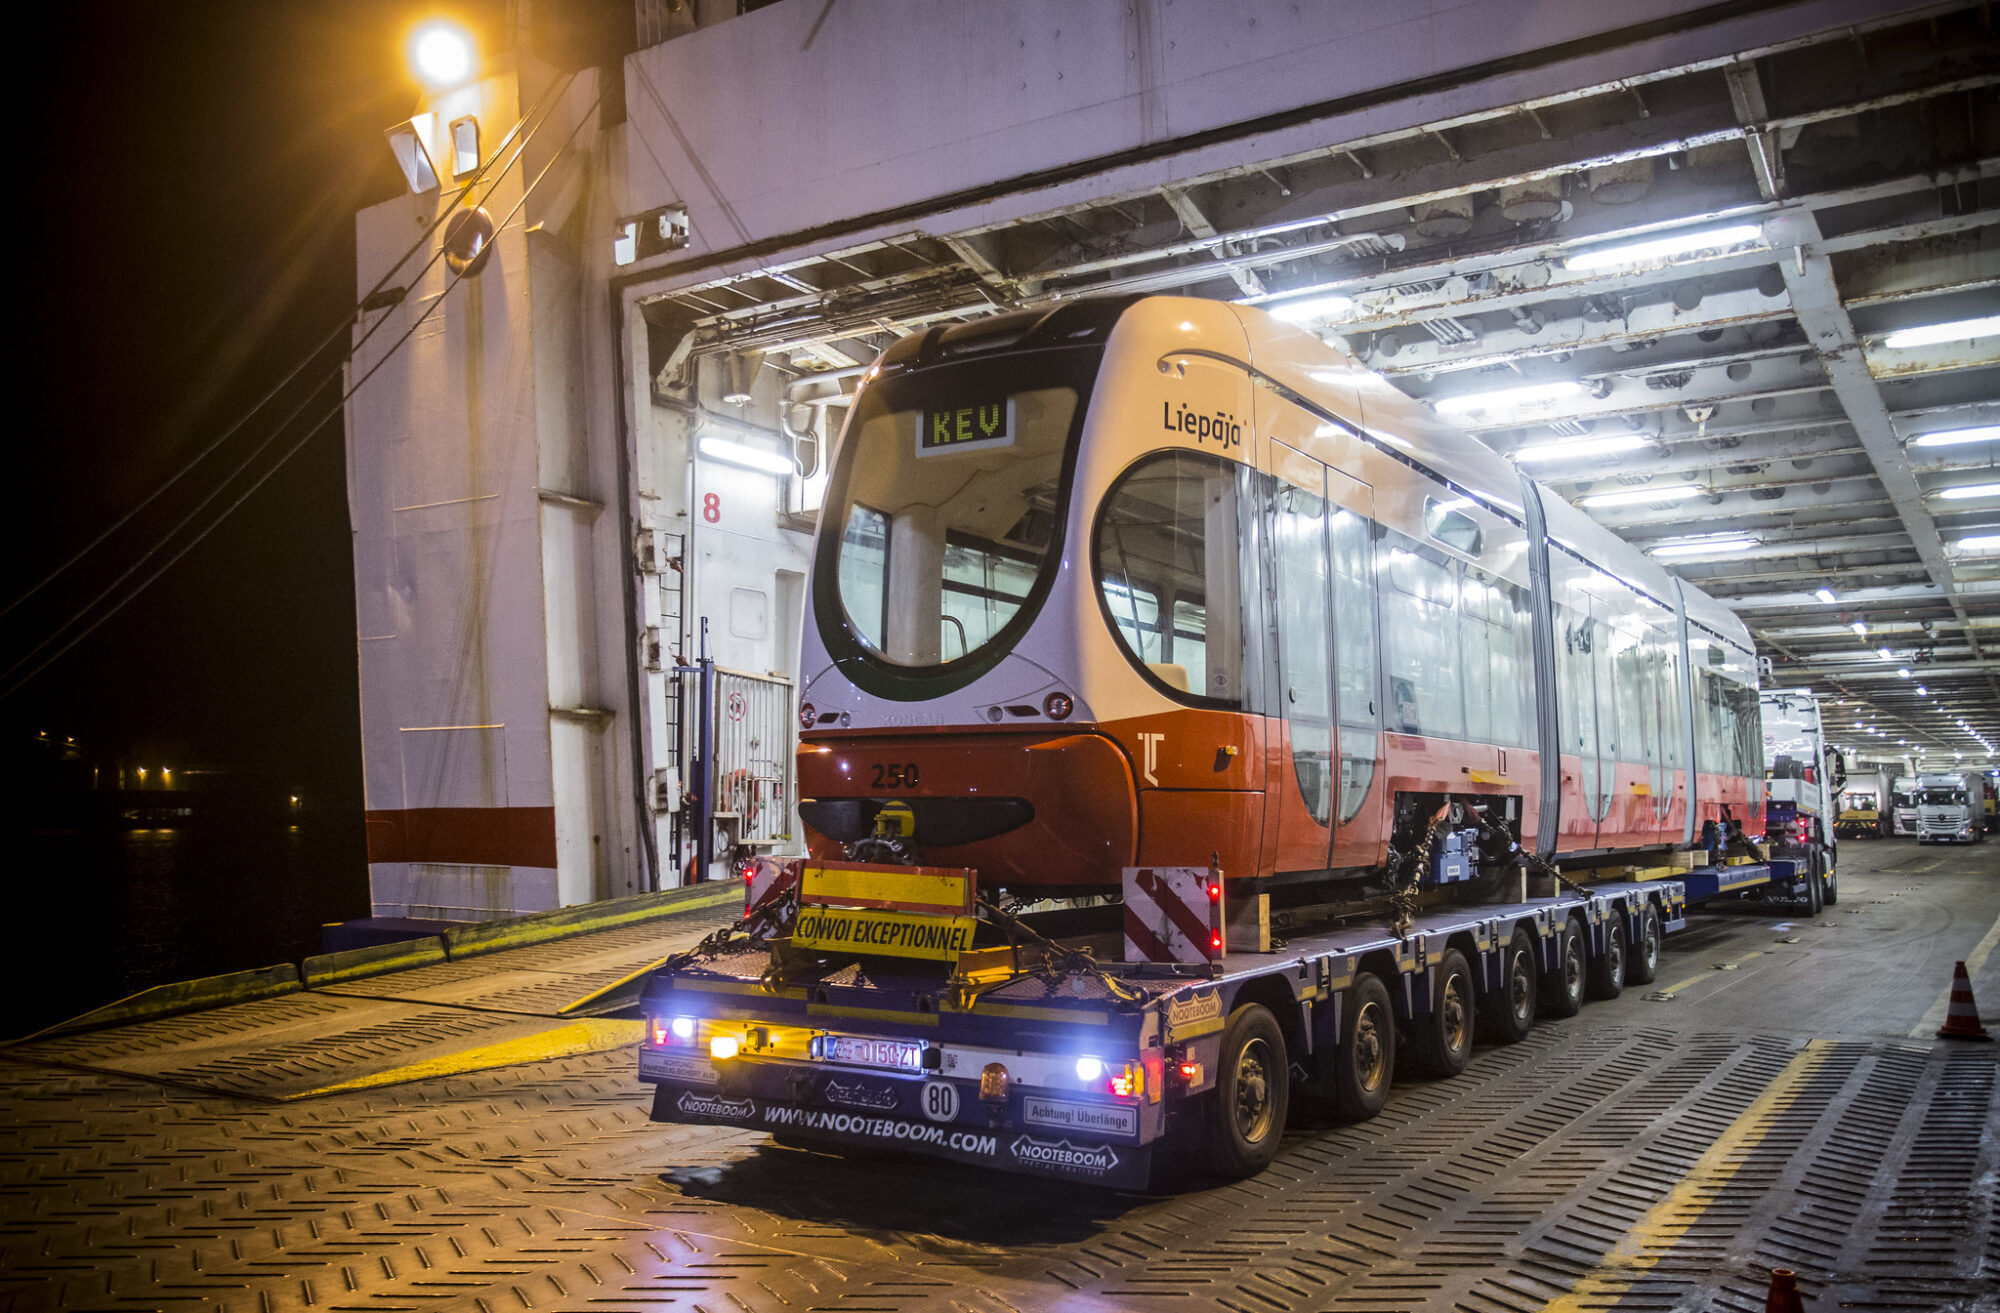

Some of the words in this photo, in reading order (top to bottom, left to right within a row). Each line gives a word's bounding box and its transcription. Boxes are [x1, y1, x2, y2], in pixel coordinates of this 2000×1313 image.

[933, 404, 999, 444] KEV
[1164, 402, 1240, 449] Liepāja
[703, 492, 720, 523] 8
[871, 763, 919, 788] 250
[797, 916, 852, 942] CONVOI
[853, 920, 968, 950] EXCEPTIONNEL
[1173, 1001, 1217, 1021] NOOTEBOOM
[684, 1101, 748, 1116] NOOTEBOOM
[929, 1085, 952, 1115] 80
[764, 1106, 997, 1156] WWW.NOOTEBOOM.COM
[1032, 1105, 1074, 1123] Achtung!
[1077, 1108, 1128, 1129] Überlänge
[1020, 1145, 1107, 1168] NOOTEBOOM
